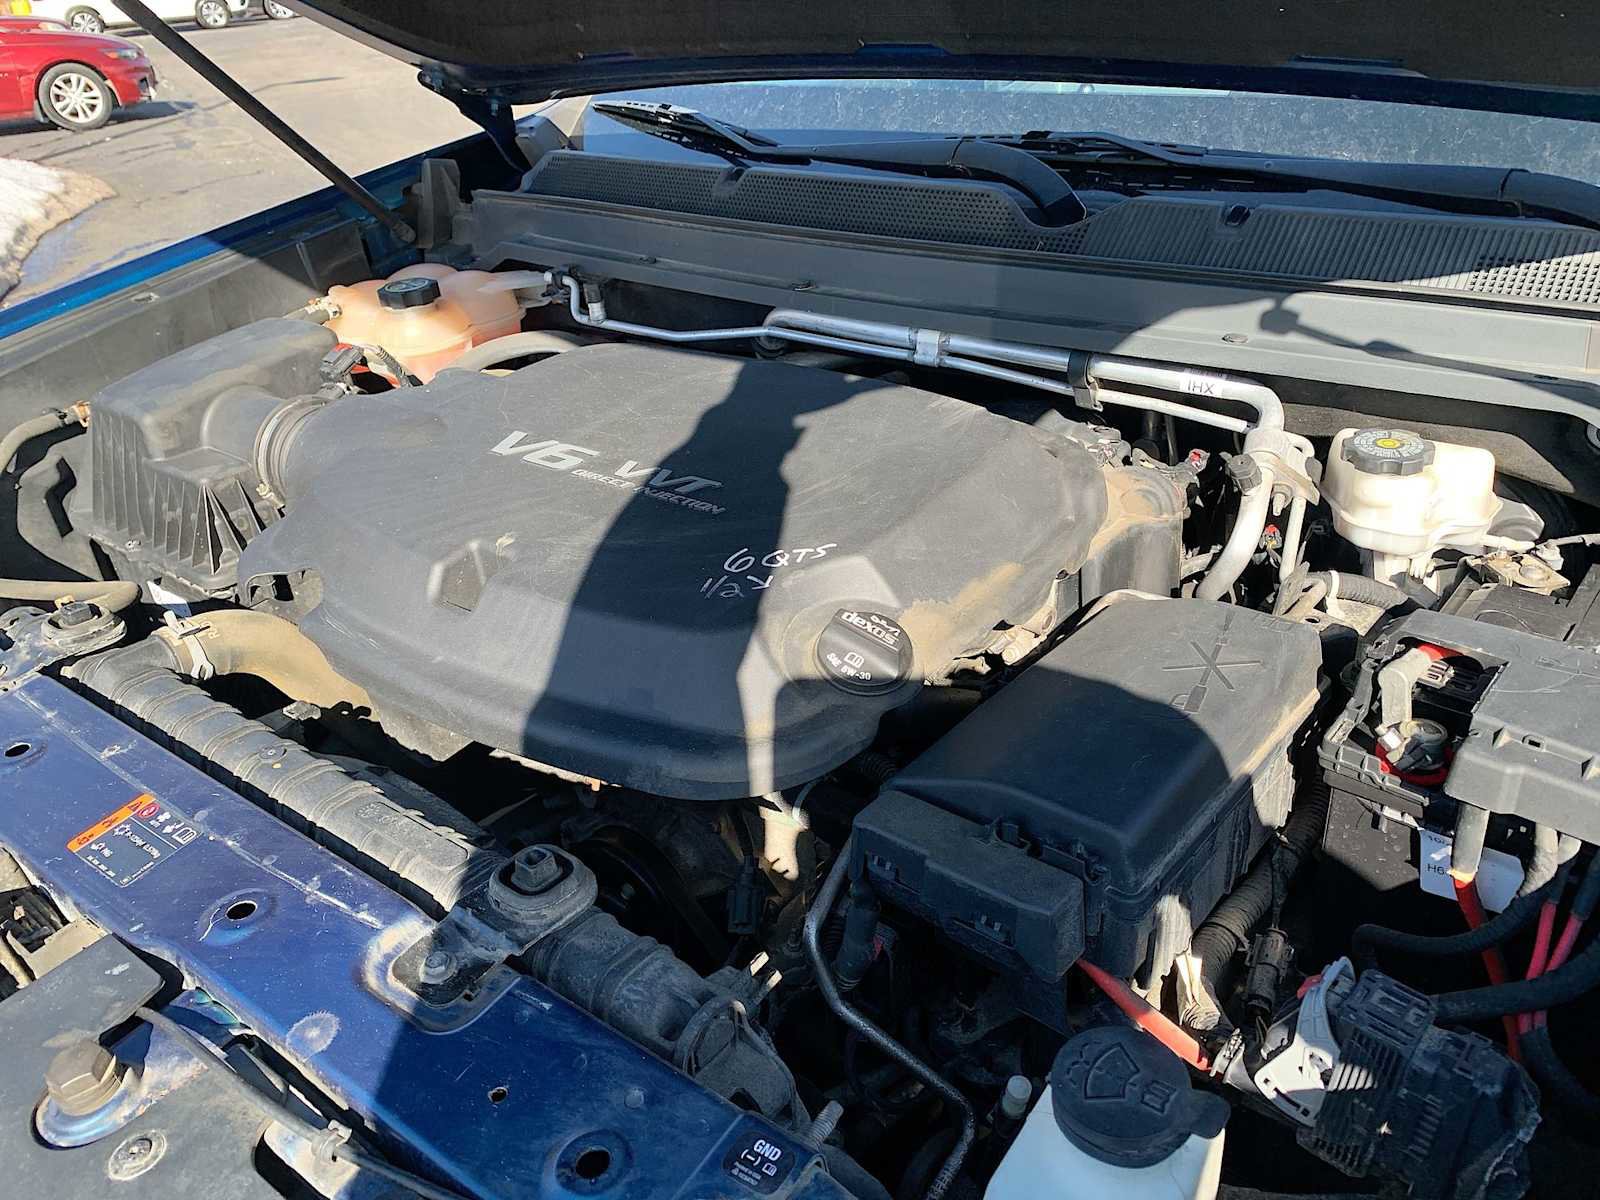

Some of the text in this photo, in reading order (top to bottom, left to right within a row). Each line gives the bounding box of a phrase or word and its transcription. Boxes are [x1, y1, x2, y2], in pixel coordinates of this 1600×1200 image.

[489, 430, 600, 470] V6
[571, 468, 726, 516] DIRECT INJECTION
[614, 460, 723, 494] VVT
[723, 543, 838, 573] 6 QTS
[840, 611, 900, 646] dexos
[753, 1139, 782, 1162] GND
